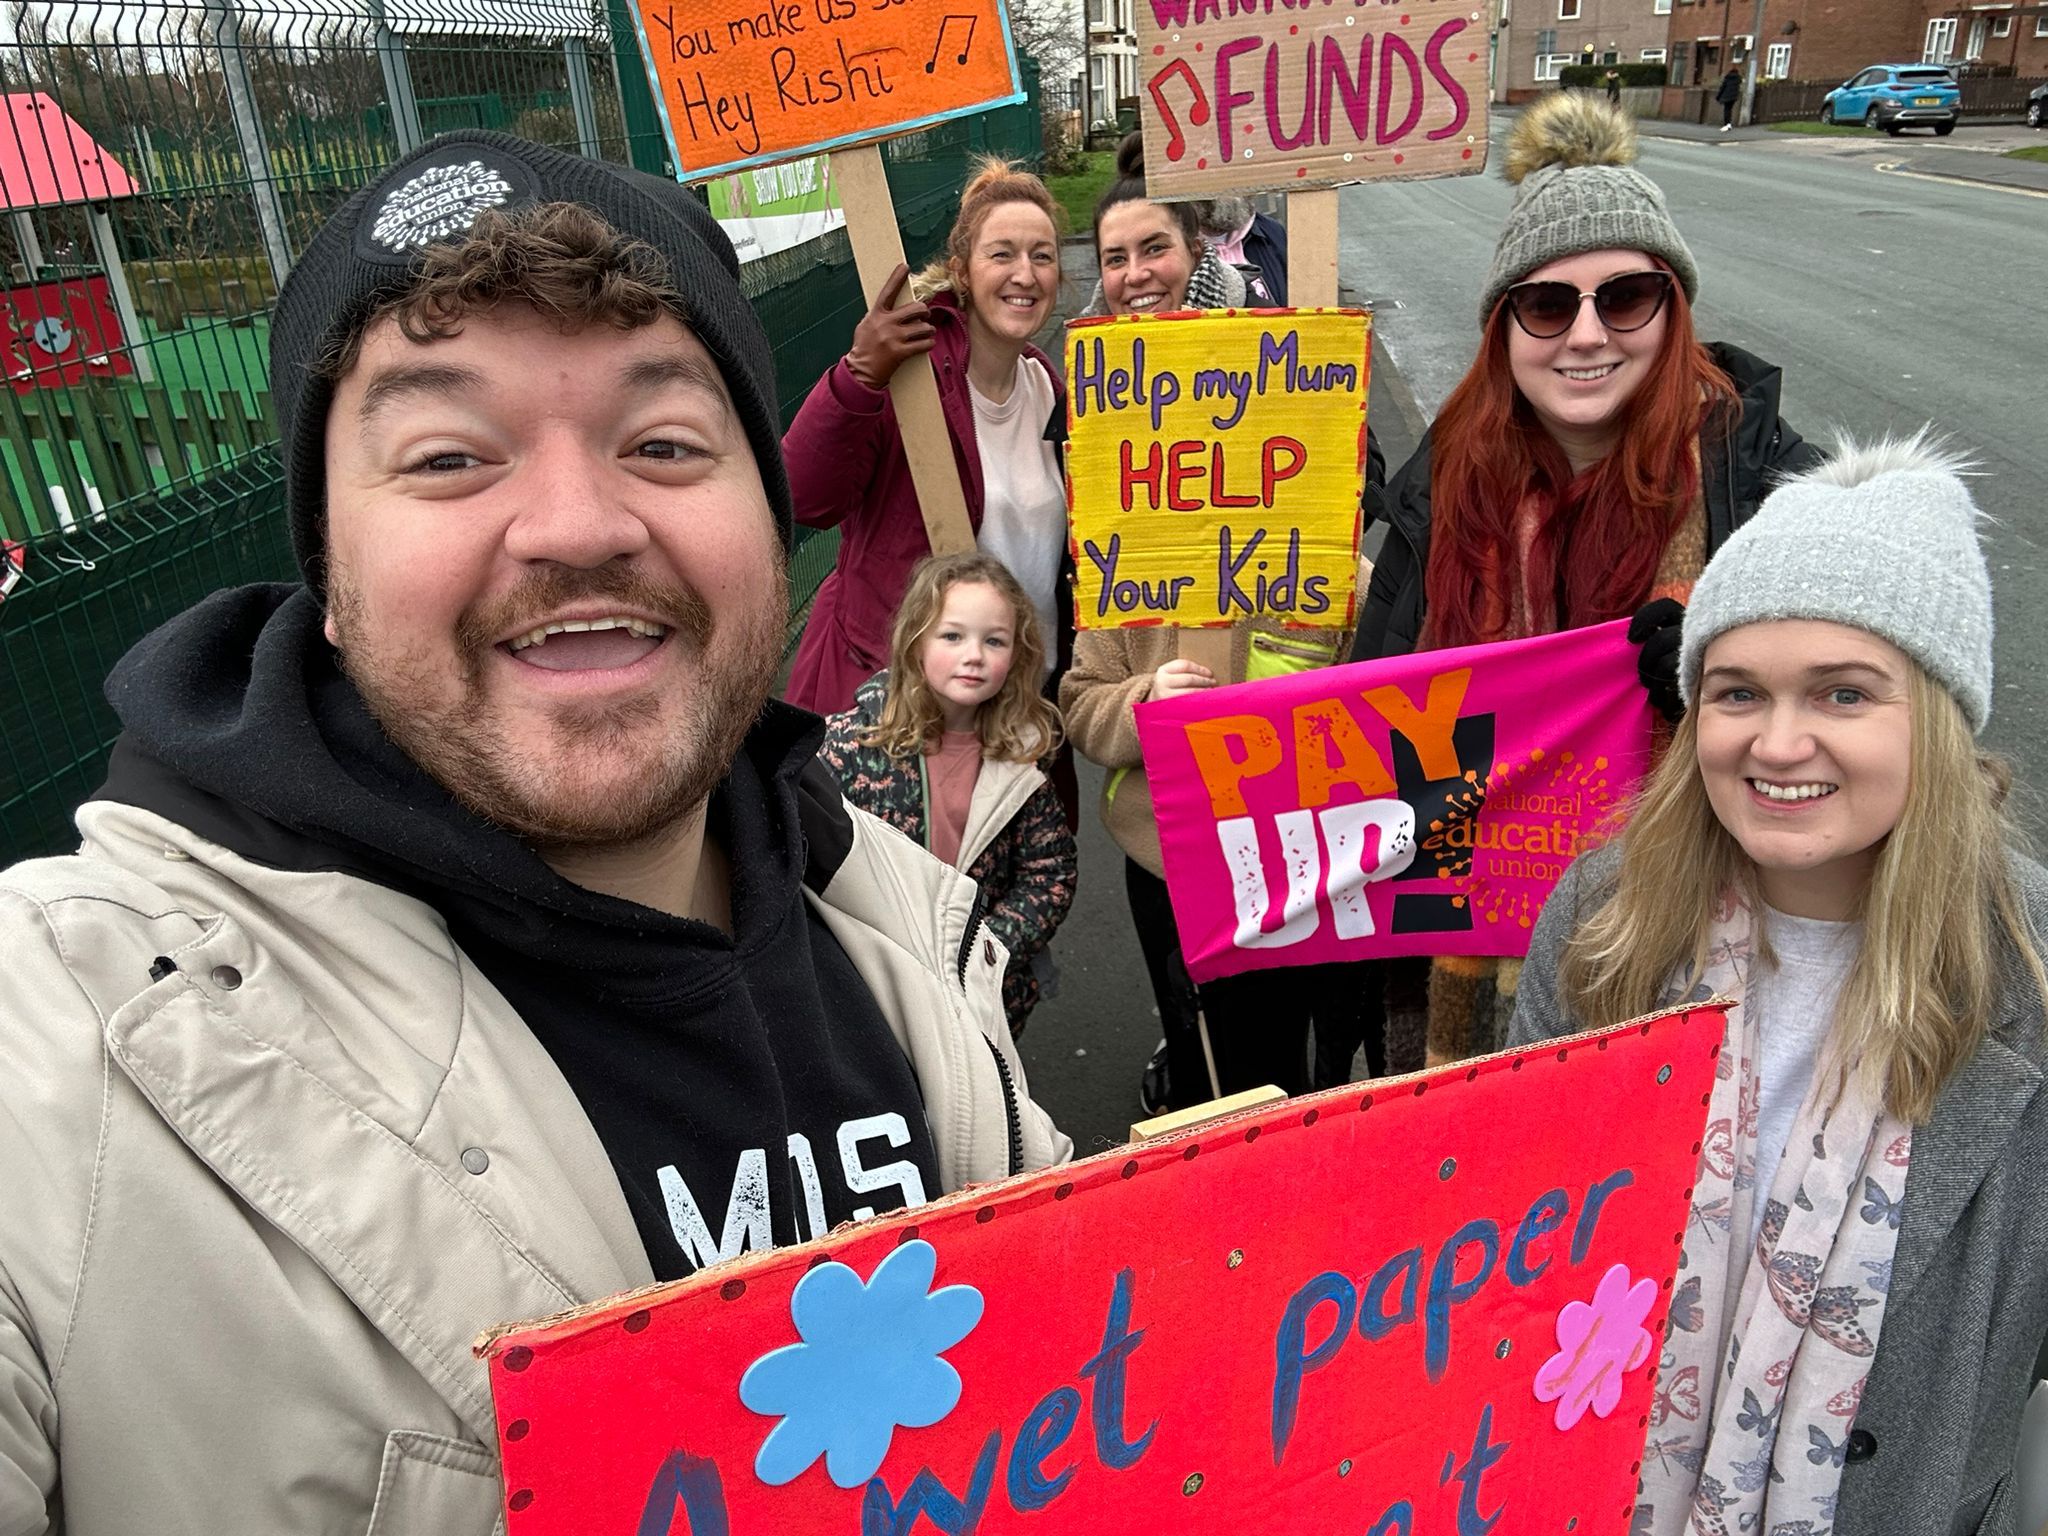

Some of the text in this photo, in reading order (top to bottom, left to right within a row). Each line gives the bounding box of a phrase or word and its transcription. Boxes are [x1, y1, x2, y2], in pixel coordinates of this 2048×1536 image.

[652, 5, 718, 64] You
[727, 0, 805, 46] make
[677, 38, 896, 155] Hey Rishi
[1214, 18, 1470, 163] FUNDS
[373, 180, 509, 238] education
[403, 174, 469, 207] national
[415, 201, 465, 225] union
[1075, 330, 1358, 431] Help my Mum
[1120, 435, 1308, 512] HELP
[1083, 525, 1331, 618] Your Kids
[1184, 667, 1474, 818] PAY
[1489, 857, 1564, 881] union
[861, 1265, 1163, 1536] wet
[1271, 1168, 1635, 1468] paper
